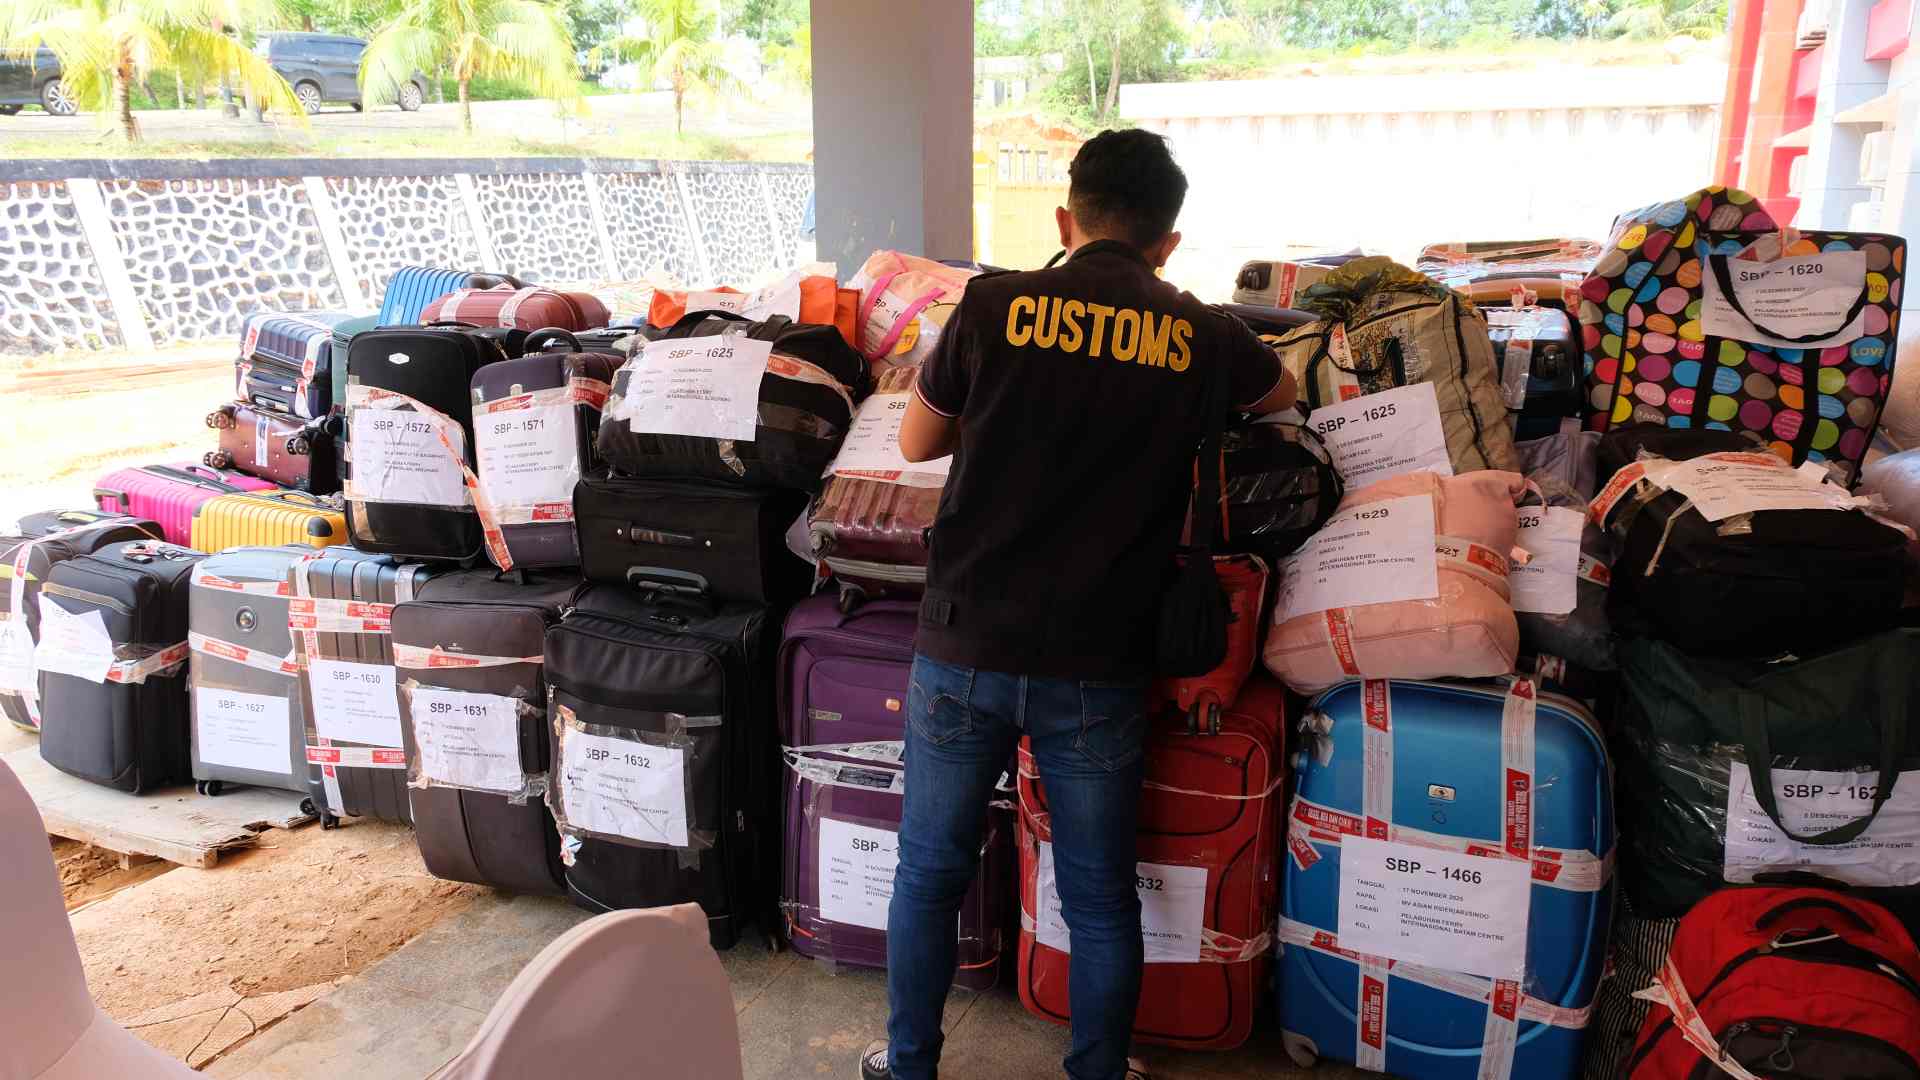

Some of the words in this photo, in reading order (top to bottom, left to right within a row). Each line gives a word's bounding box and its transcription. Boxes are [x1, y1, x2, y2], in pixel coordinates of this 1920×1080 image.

[1788, 263, 1823, 276] 1620
[1006, 296, 1193, 372] CUSTOMS
[668, 349, 694, 359] SBP
[706, 347, 735, 358] 1625
[887, 401, 906, 410] SB
[1318, 416, 1346, 435] SBP
[1362, 403, 1397, 422] 1625
[374, 420, 394, 430] SBP
[406, 422, 431, 433] 1572
[494, 423, 512, 435] SBP
[522, 419, 544, 431] 1571
[1353, 508, 1389, 520] 1629
[1518, 516, 1540, 529] 25
[333, 671, 351, 680] SBP
[361, 673, 381, 684] 1630
[246, 703, 265, 712] 1627
[430, 702, 452, 713] SBP
[463, 705, 487, 716] 1631
[585, 747, 610, 761] SBP
[624, 753, 650, 768] 1632
[1783, 784, 1824, 798] SBP
[1847, 786, 1892, 800] 162
[852, 838, 879, 852] SBP
[1385, 857, 1422, 874] SBP
[1442, 866, 1482, 885] 1466
[1136, 876, 1164, 891] 632
[1356, 878, 1386, 889] TANGGAL
[1411, 888, 1447, 900] NOVEMBER
[1355, 903, 1380, 913] LOKASI
[1477, 931, 1505, 941] CENTRE
